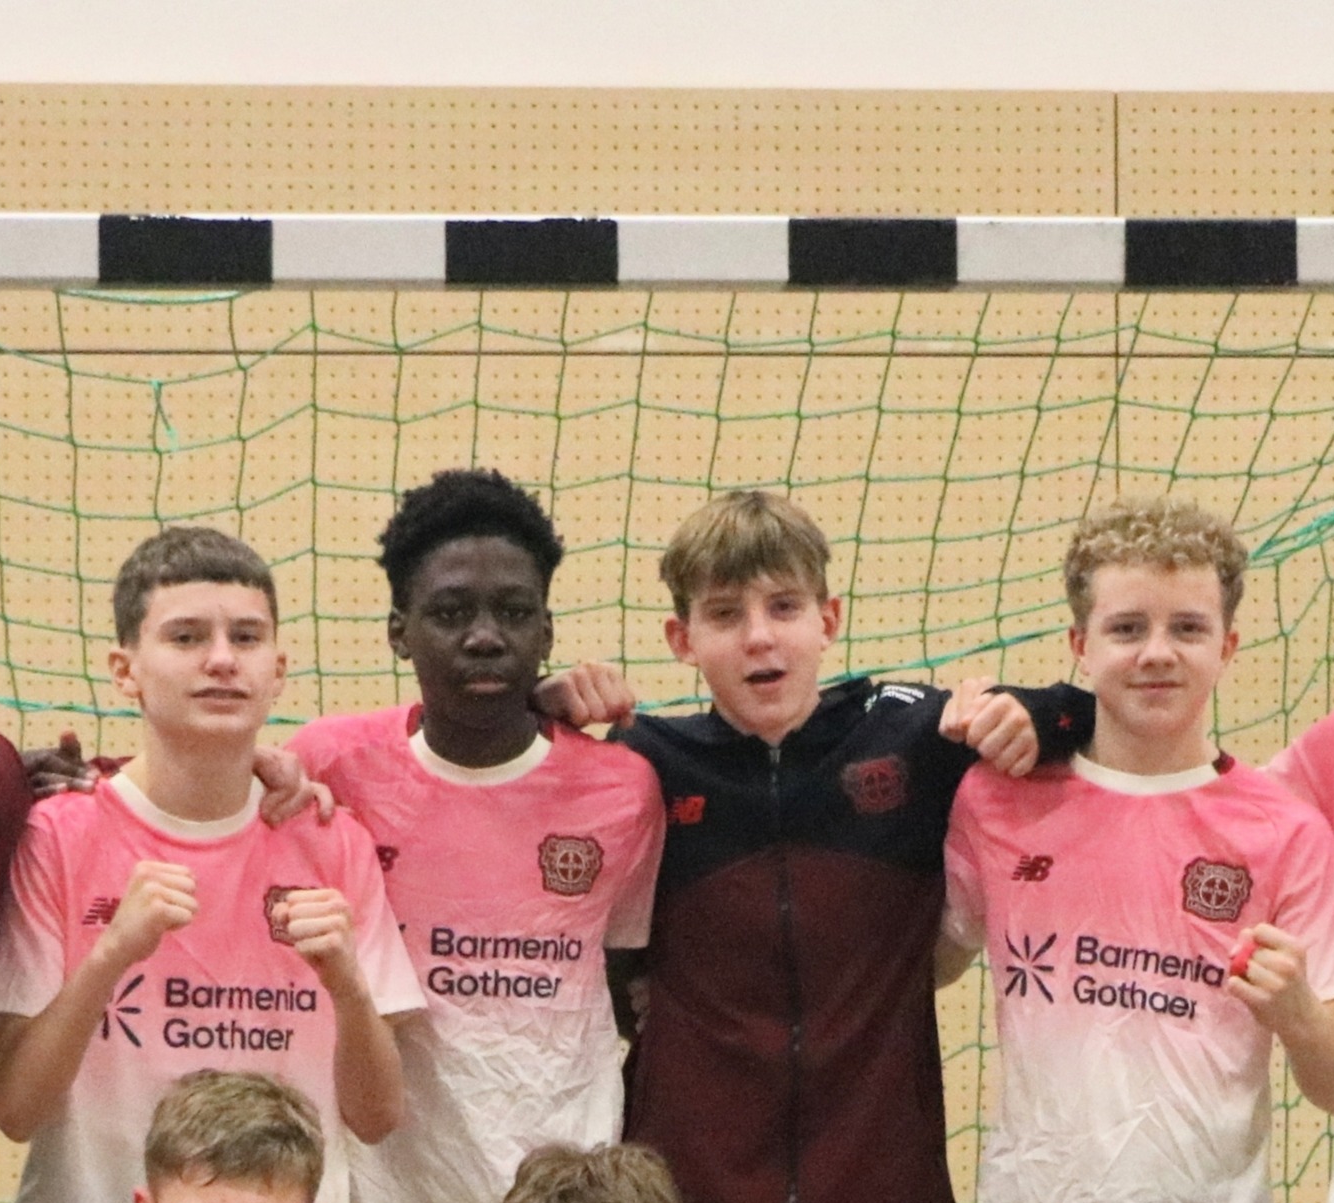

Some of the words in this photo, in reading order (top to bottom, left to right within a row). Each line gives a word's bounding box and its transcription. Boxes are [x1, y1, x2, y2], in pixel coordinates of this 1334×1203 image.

[431, 928, 582, 961] Barmenia
[1075, 935, 1224, 987] Barmenia
[166, 978, 317, 1013] Barmenia
[428, 967, 562, 999] Gothaer
[1073, 975, 1196, 1020] Gothaer
[163, 1019, 294, 1052] Gothaer
